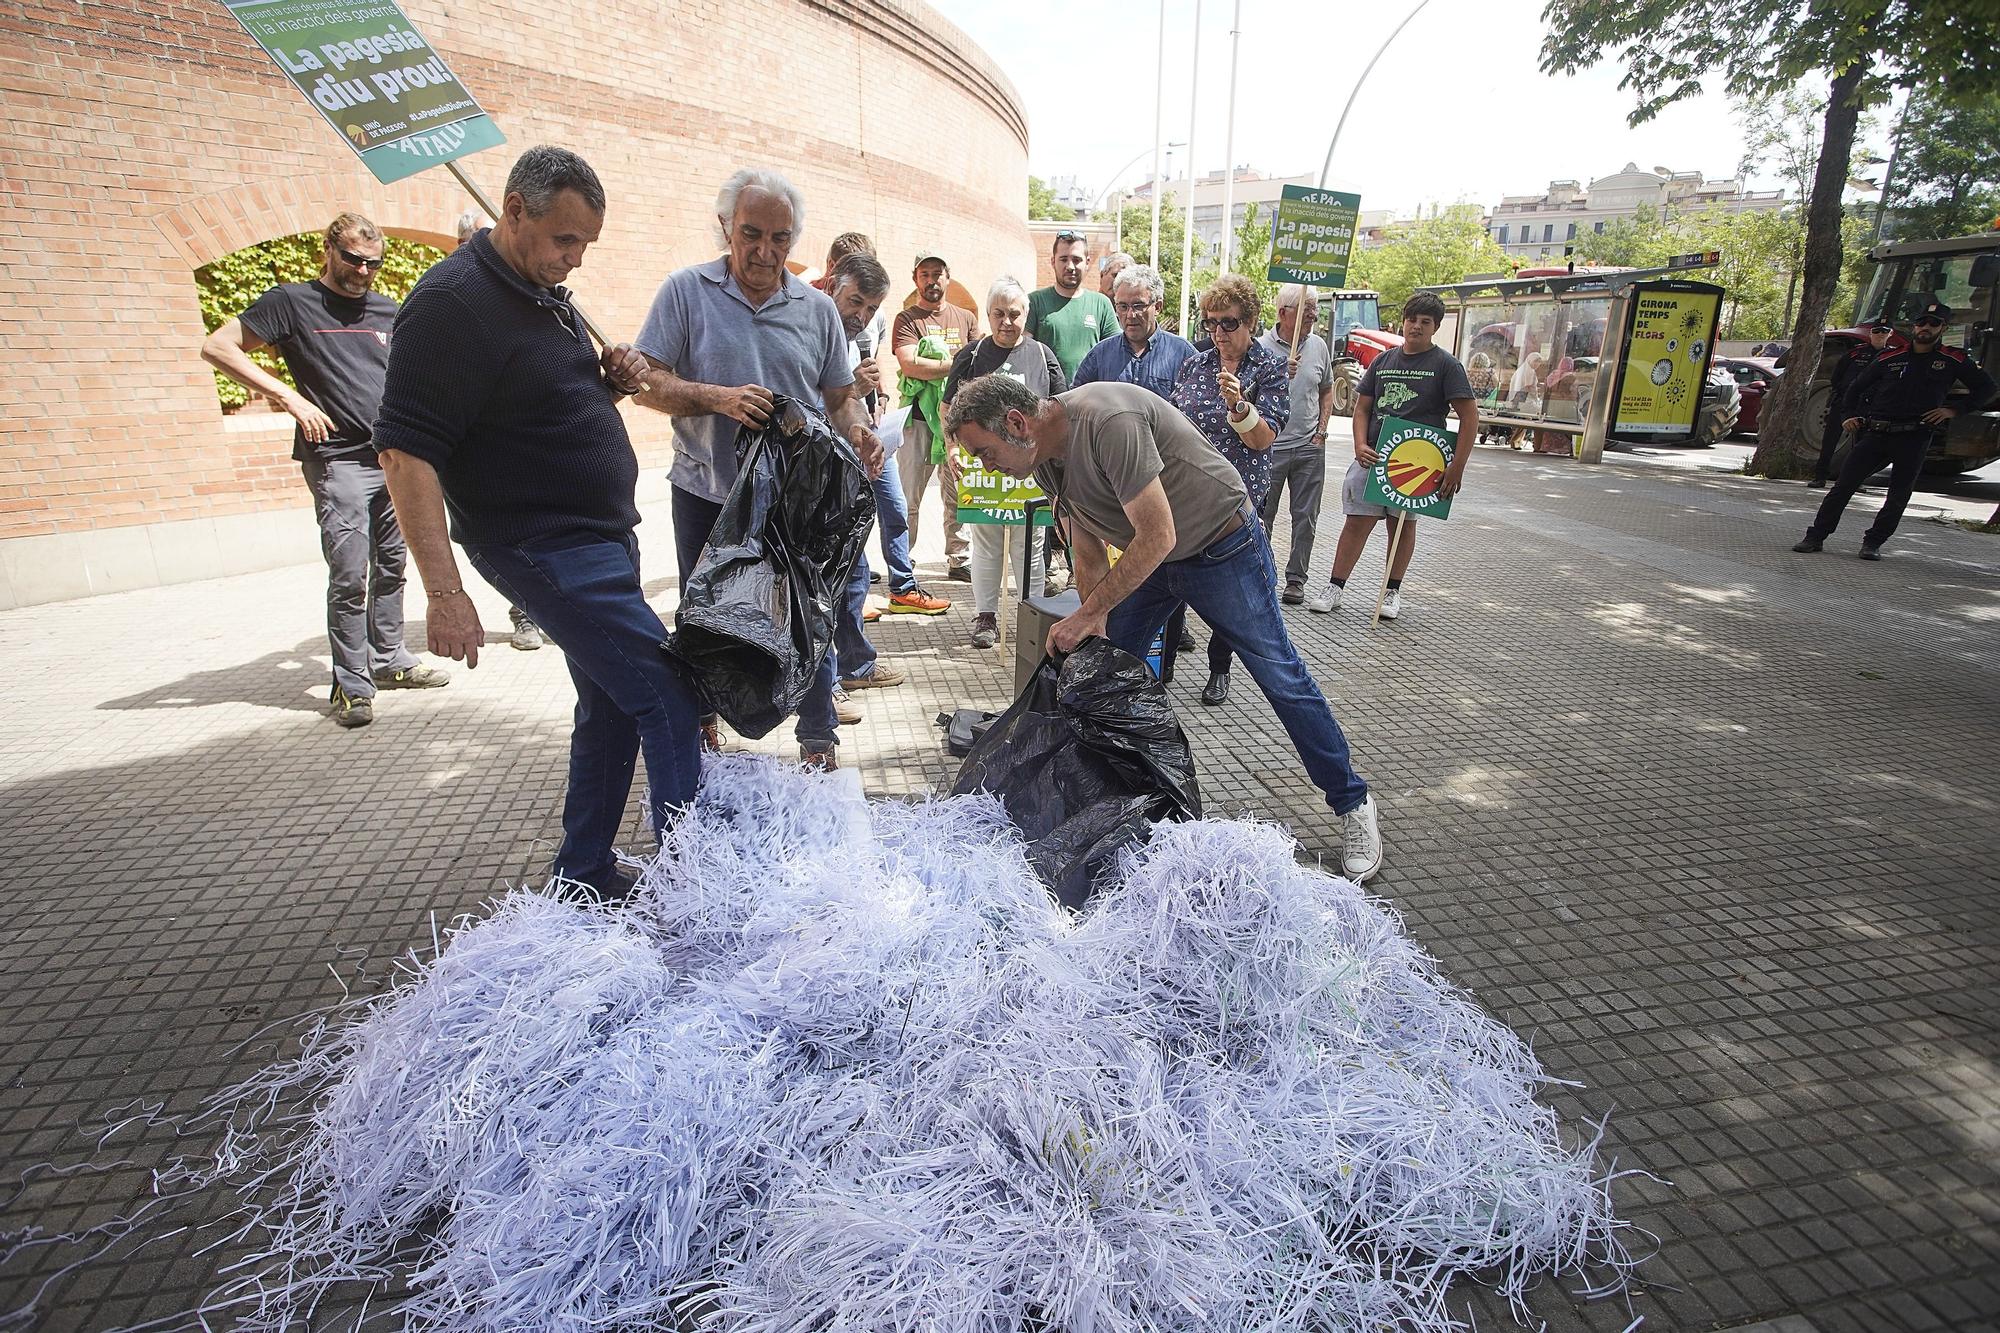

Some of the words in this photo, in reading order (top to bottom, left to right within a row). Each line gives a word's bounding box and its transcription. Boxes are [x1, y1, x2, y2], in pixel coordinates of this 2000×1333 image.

[241, 9, 274, 21] davant
[273, 7, 284, 16] la
[283, 5, 302, 15] crisi
[300, 3, 313, 13] de
[312, 2, 336, 13] preus
[248, 22, 261, 36] i
[257, 21, 277, 36] la
[272, 13, 326, 33] inacció
[324, 9, 353, 25] dels
[351, 4, 399, 24] governs
[272, 46, 325, 76] La
[319, 23, 426, 73] pagesia
[313, 72, 377, 112] diu
[368, 55, 453, 104] prou!
[408, 98, 474, 122] #LaPagesiaDiuProu
[362, 119, 382, 132] UNIÓ
[368, 129, 381, 139] DE
[378, 121, 408, 137] PAGESOS
[386, 120, 468, 157] ATALU
[1316, 211, 1330, 219] dels
[1329, 213, 1355, 222] governs
[1279, 218, 1296, 232] La
[1299, 223, 1352, 239] pagesia
[1276, 234, 1303, 251] diu
[1306, 240, 1350, 256] prou!
[1286, 268, 1327, 282] ATALU
[1638, 309, 1670, 319] TEMPS
[1640, 299, 1678, 310] GIRONA
[1636, 320, 1649, 329] DE
[1634, 331, 1666, 340] FLORS
[1378, 432, 1402, 463] UNIÓ
[1403, 427, 1422, 440] DE
[1423, 429, 1455, 464] PAGES
[961, 455, 983, 469] La
[962, 471, 996, 489] diu
[1001, 478, 1040, 493] pro
[1375, 466, 1387, 485] DE
[1381, 484, 1441, 509] CATALUN
[980, 507, 1027, 521] ATAL
